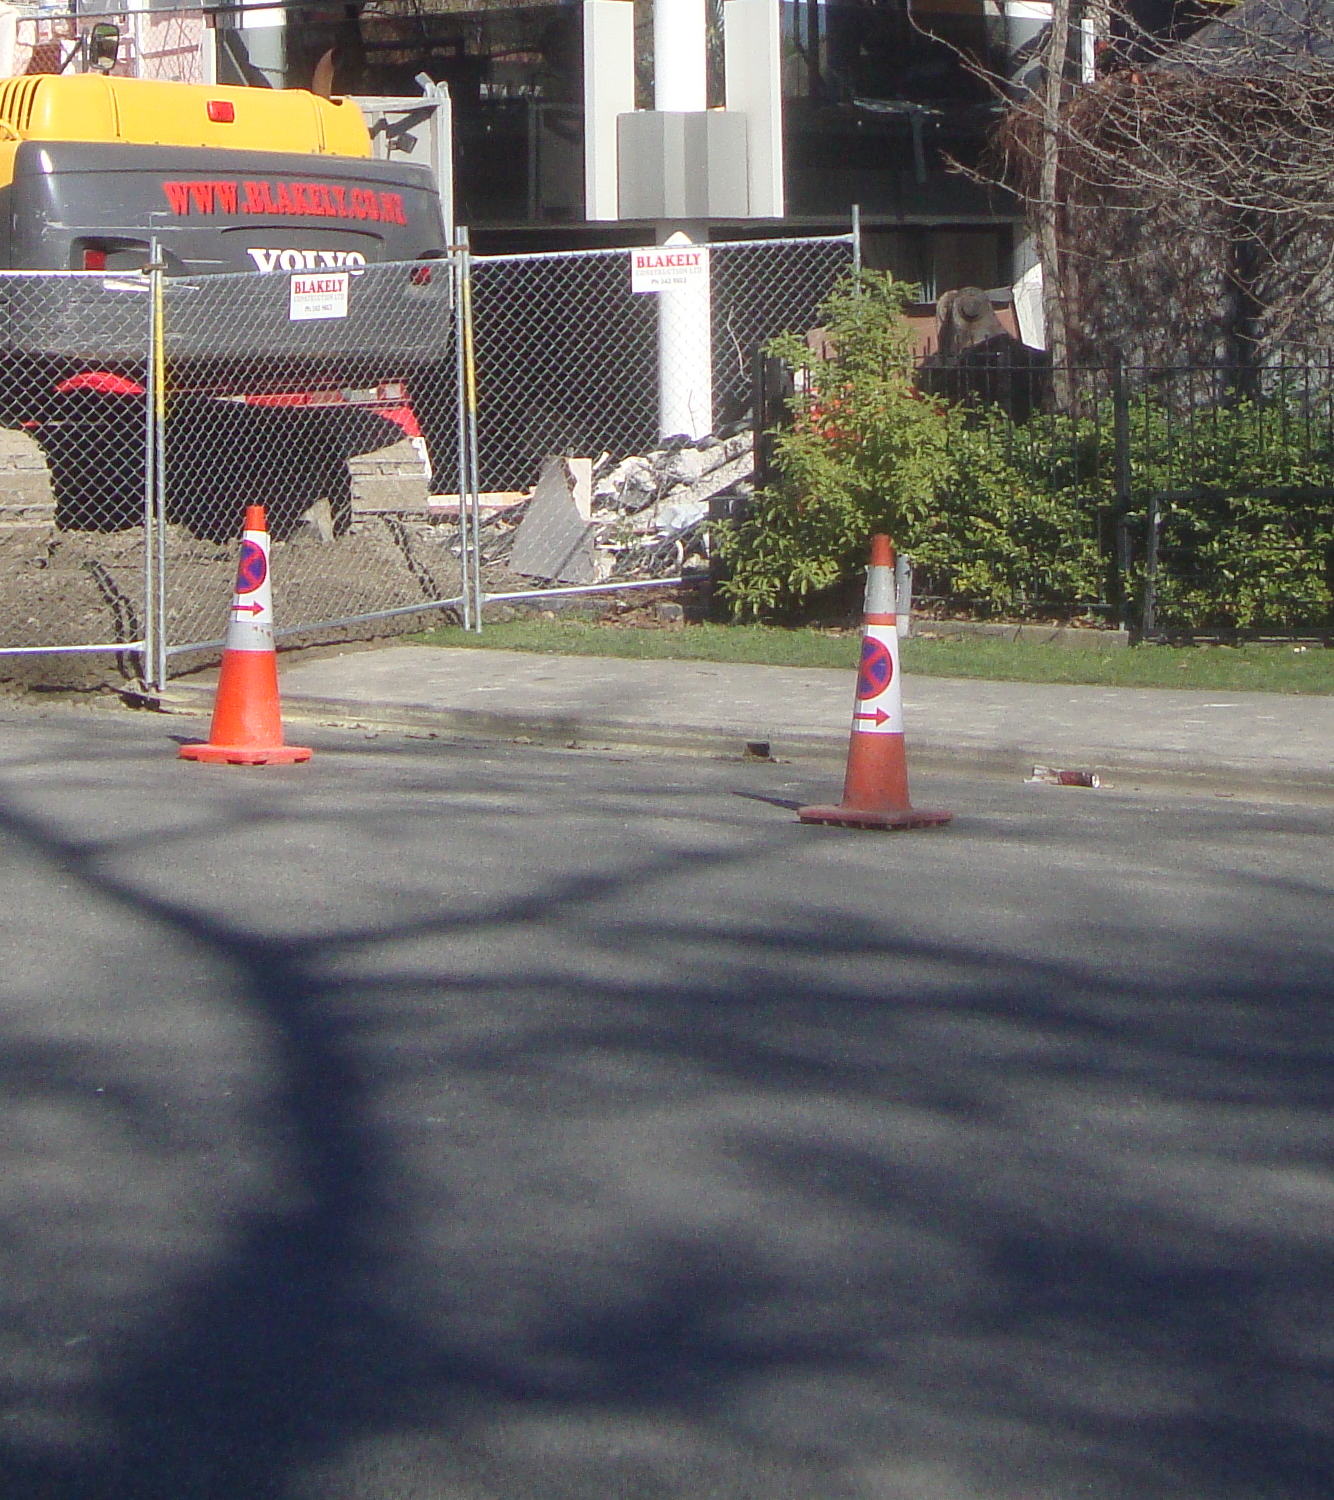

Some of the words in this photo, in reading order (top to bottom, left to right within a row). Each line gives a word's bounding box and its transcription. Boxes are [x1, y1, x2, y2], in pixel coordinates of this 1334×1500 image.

[162, 181, 407, 226] WWW.BLAKELY.CO.NZ
[247, 248, 367, 276] VOLVO
[636, 253, 701, 268] BLAKELY
[636, 268, 688, 276] CONSTRUCTION
[689, 266, 703, 274] LTD
[294, 278, 344, 294] BLAKELY
